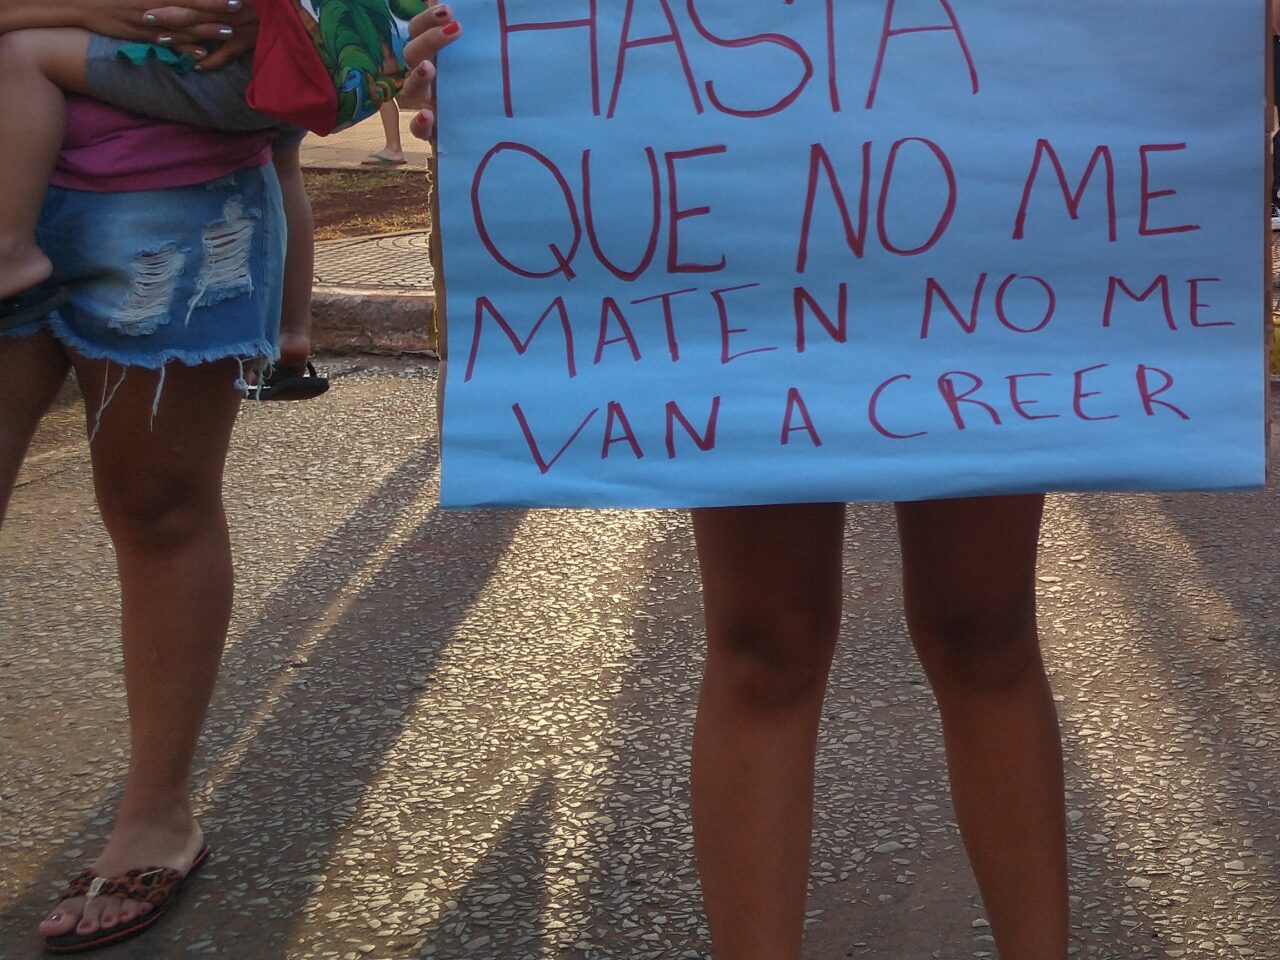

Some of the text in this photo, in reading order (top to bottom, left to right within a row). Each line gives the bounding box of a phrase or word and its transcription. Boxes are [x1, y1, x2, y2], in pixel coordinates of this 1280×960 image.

[471, 137, 1201, 282] QUE NO ME
[464, 272, 1236, 383] MATEN NO ME
[511, 363, 1191, 475] VAN A CREER
